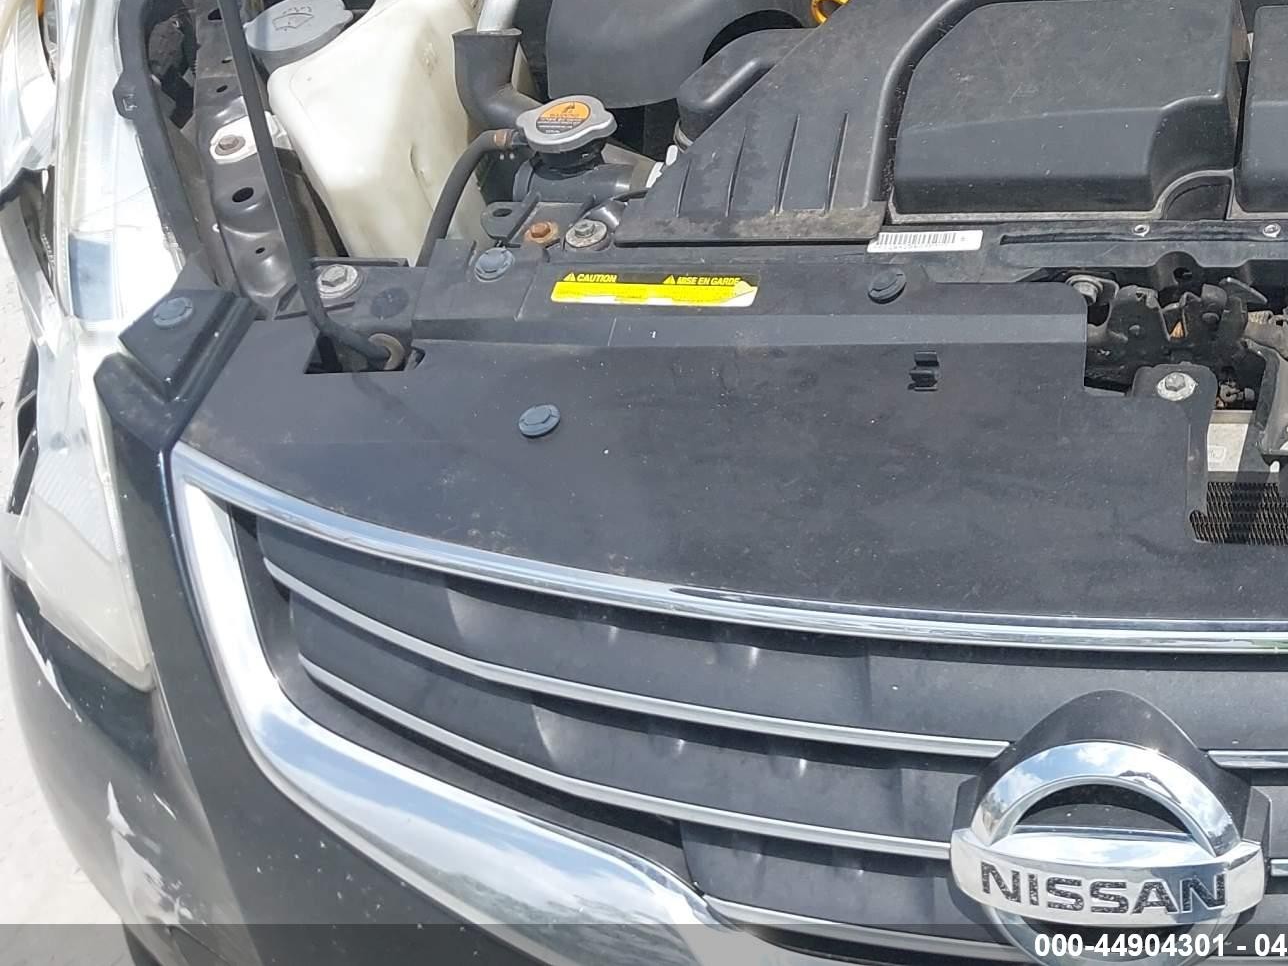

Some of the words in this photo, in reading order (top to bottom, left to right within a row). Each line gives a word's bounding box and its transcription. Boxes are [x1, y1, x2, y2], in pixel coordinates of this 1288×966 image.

[576, 273, 618, 283] CAUTION
[698, 276, 710, 285] EN
[980, 860, 1226, 915] NISSAN
